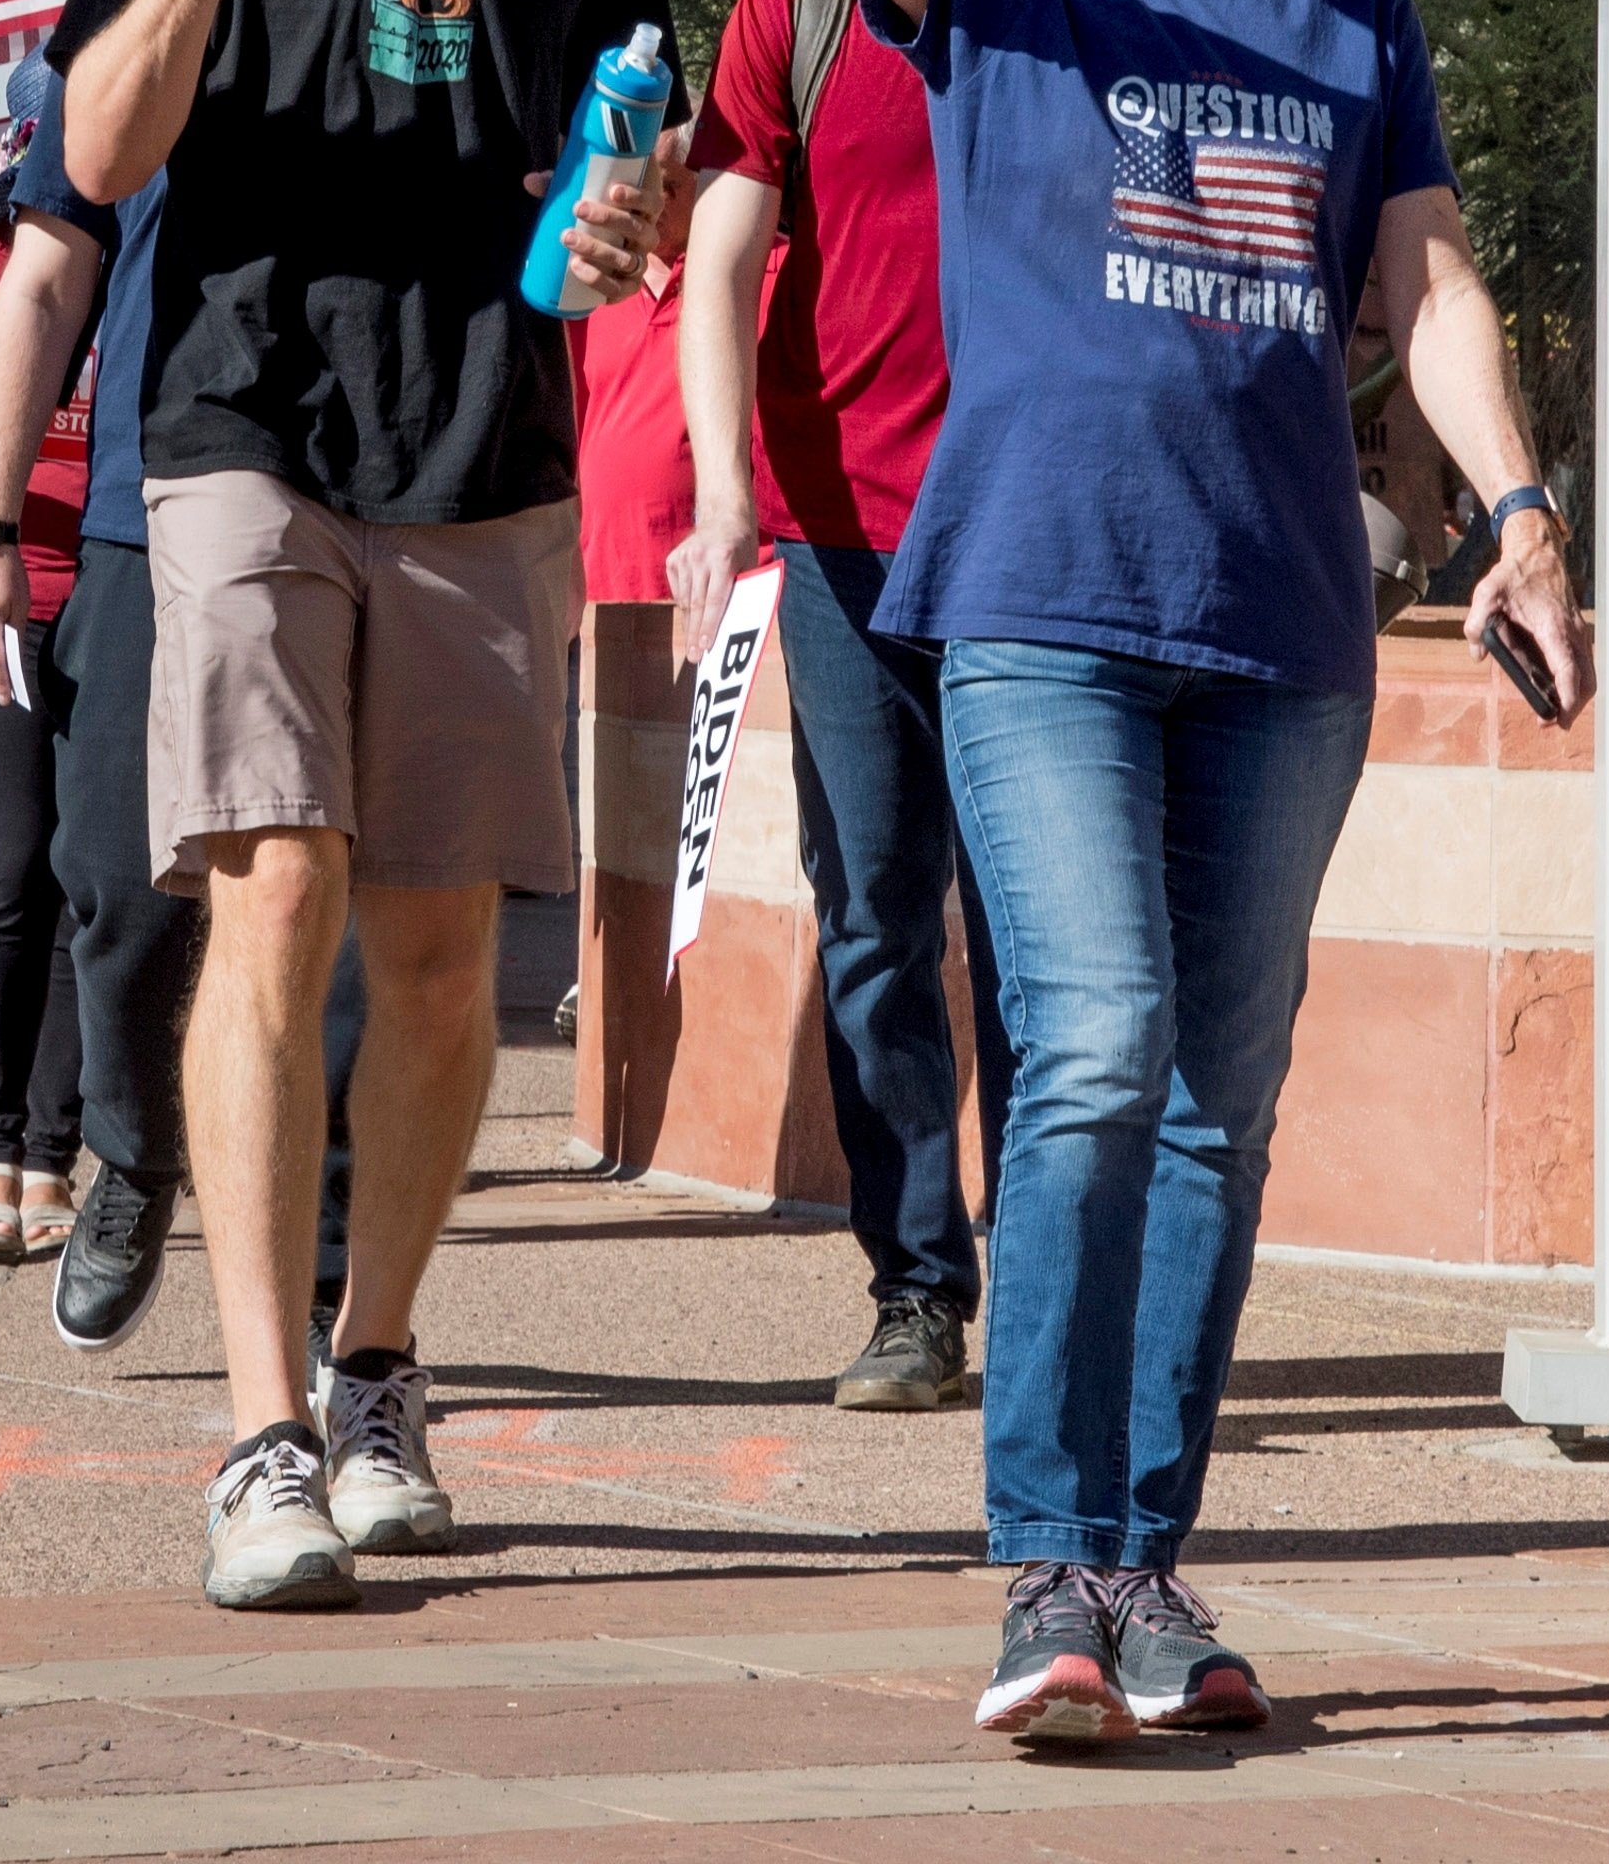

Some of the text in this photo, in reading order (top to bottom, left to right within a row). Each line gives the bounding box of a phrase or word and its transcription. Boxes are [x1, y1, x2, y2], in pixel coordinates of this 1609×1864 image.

[416, 38, 470, 75] 2020
[1107, 75, 1334, 152] QUESTION
[1105, 250, 1327, 336] EVERYTHING
[688, 628, 761, 891] BIDEN
